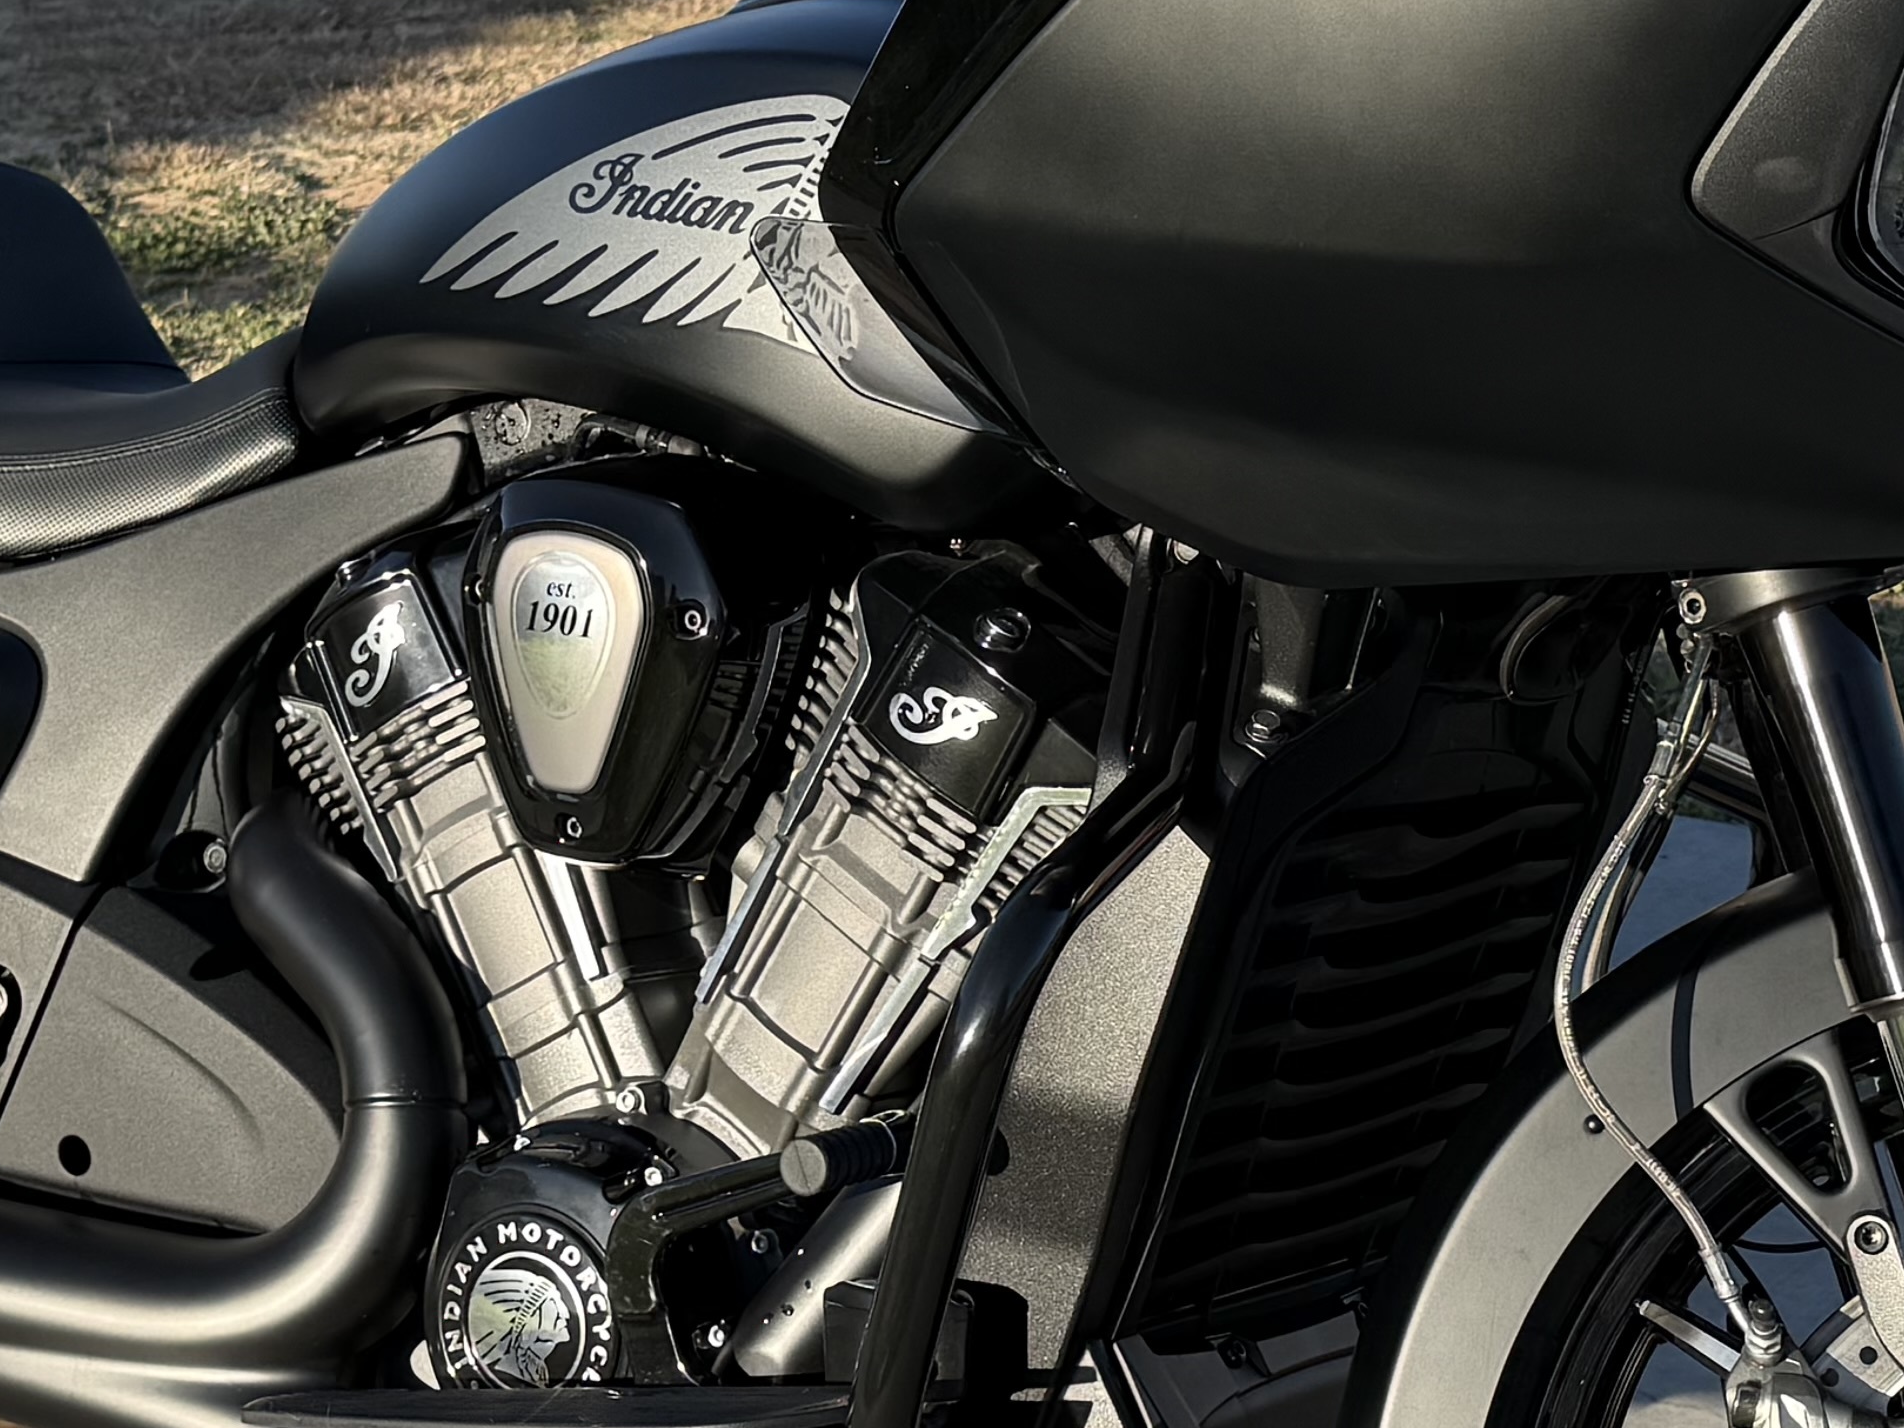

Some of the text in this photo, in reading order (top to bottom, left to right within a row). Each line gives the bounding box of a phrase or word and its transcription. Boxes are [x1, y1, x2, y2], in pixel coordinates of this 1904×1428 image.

[568, 151, 755, 234] Indian
[524, 600, 594, 639] 1901
[545, 579, 576, 600] est.
[442, 1220, 612, 1384] INDIAN MOTORCYCL
